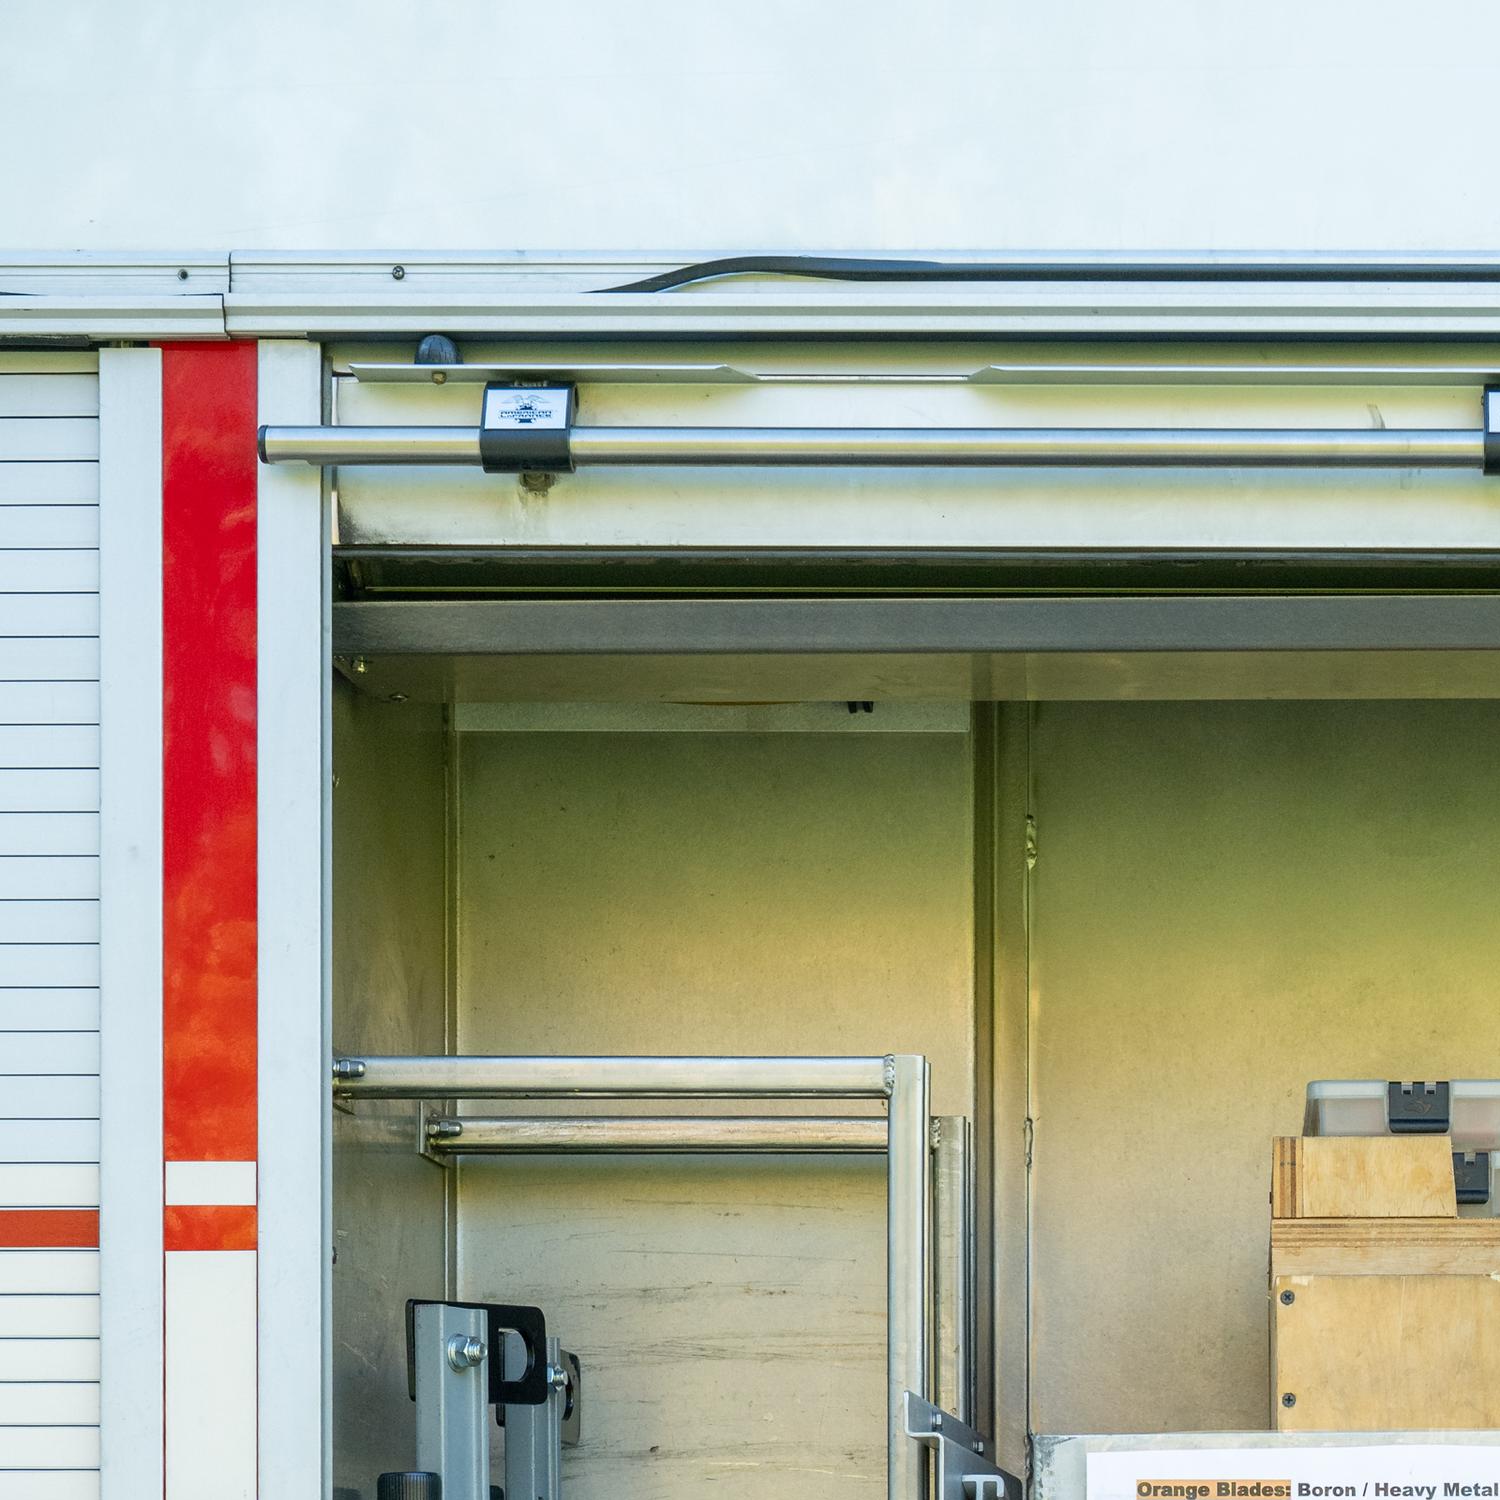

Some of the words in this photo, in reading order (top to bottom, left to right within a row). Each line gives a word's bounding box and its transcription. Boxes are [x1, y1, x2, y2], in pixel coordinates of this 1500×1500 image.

[1137, 1482, 1210, 1500] Orange
[1217, 1482, 1291, 1497] Blades:
[1298, 1482, 1356, 1497] Boron
[1375, 1482, 1437, 1500] Heavy
[1443, 1482, 1499, 1497] Metal
